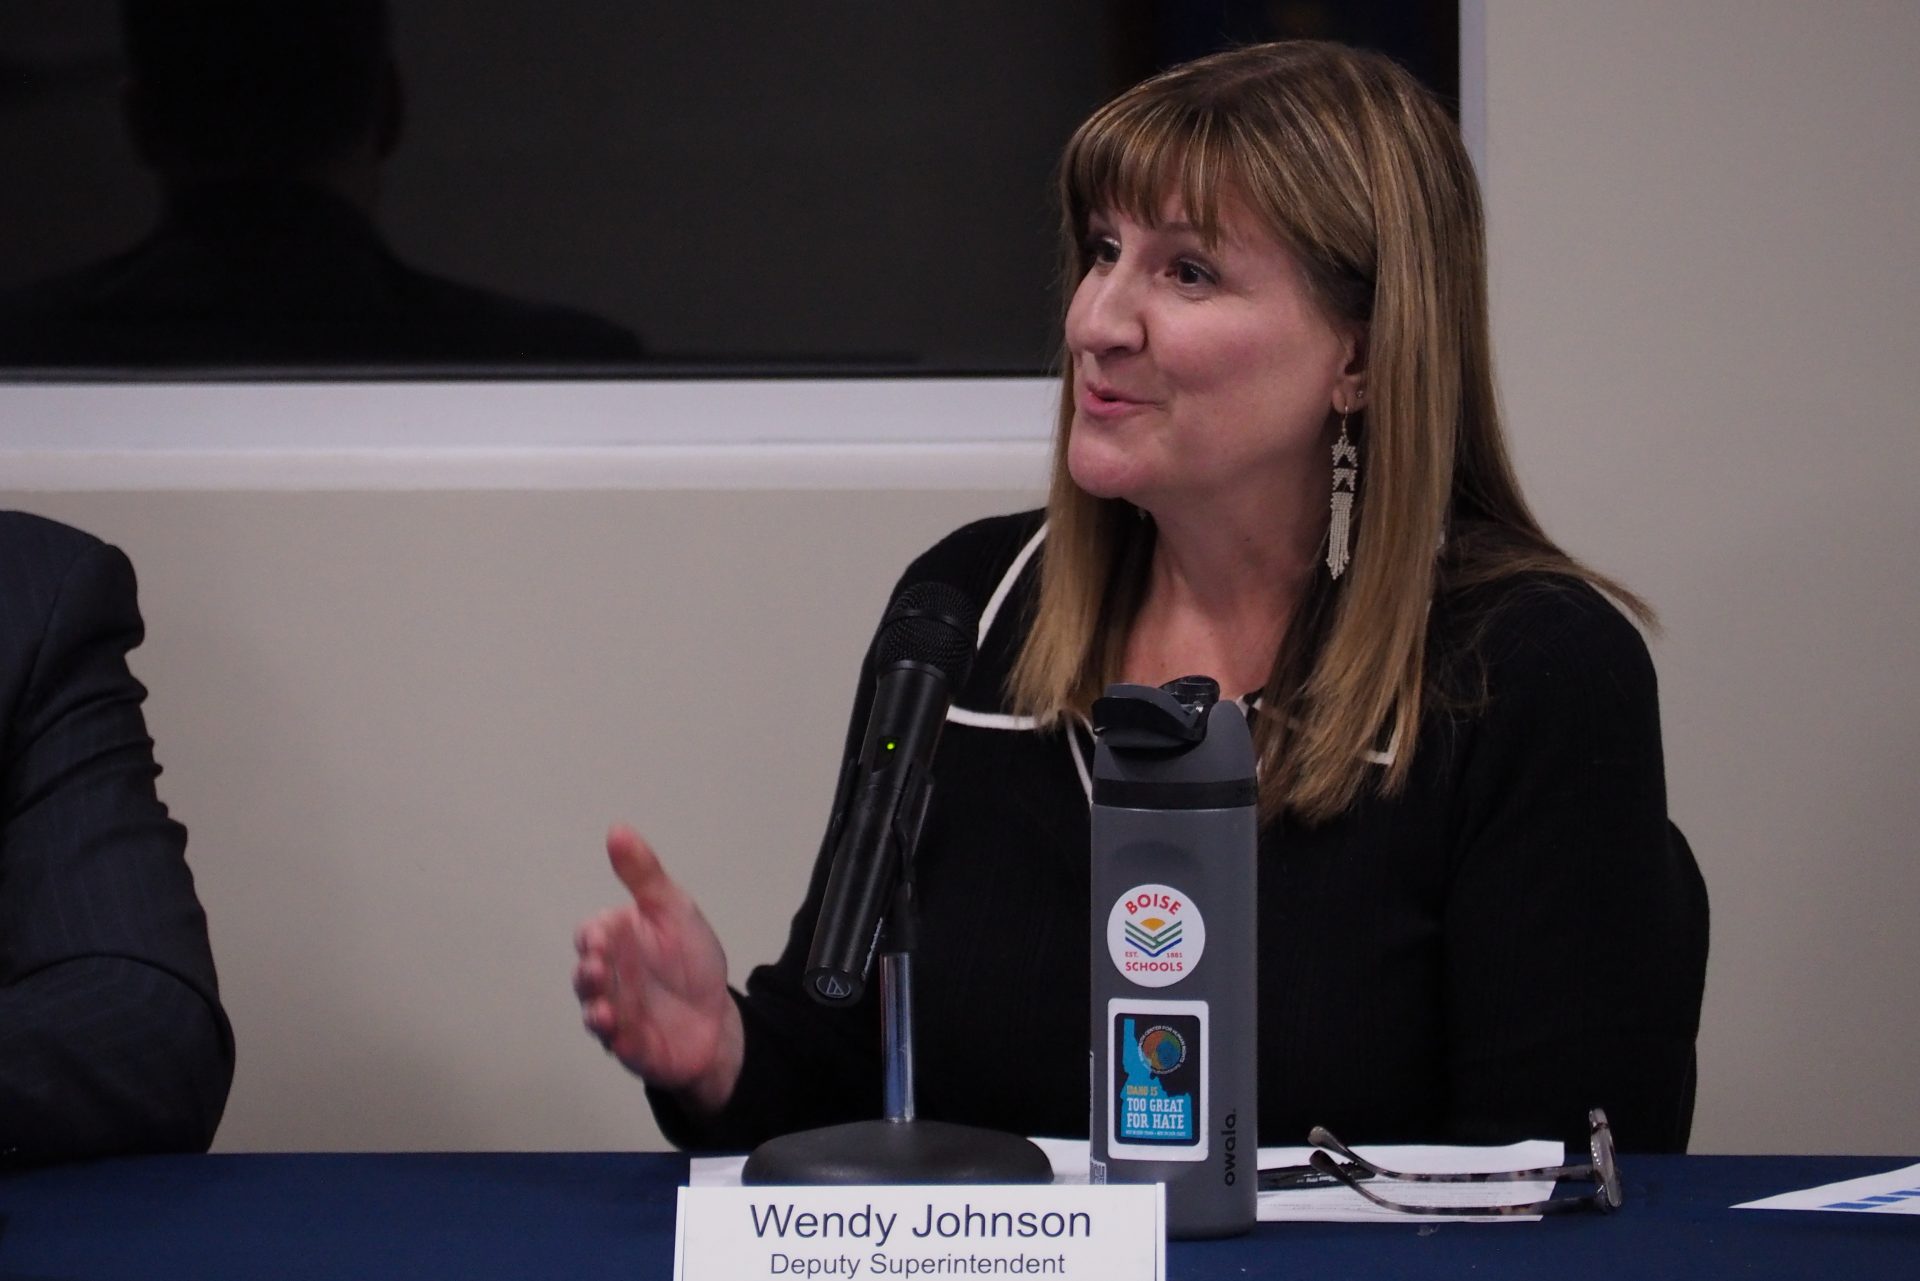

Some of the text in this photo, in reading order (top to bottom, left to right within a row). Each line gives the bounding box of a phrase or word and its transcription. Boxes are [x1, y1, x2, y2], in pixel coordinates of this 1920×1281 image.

[1125, 893, 1182, 915] BOISE
[1125, 961, 1183, 972] SCHOOLS
[1150, 1086, 1158, 1096] IS
[1126, 1097, 1184, 1113] TOO GREAT
[1126, 1112, 1185, 1130] FOR HATE
[750, 1203, 1091, 1247] Wendy Johnson
[770, 1253, 1065, 1279] Deputy Superintendent
